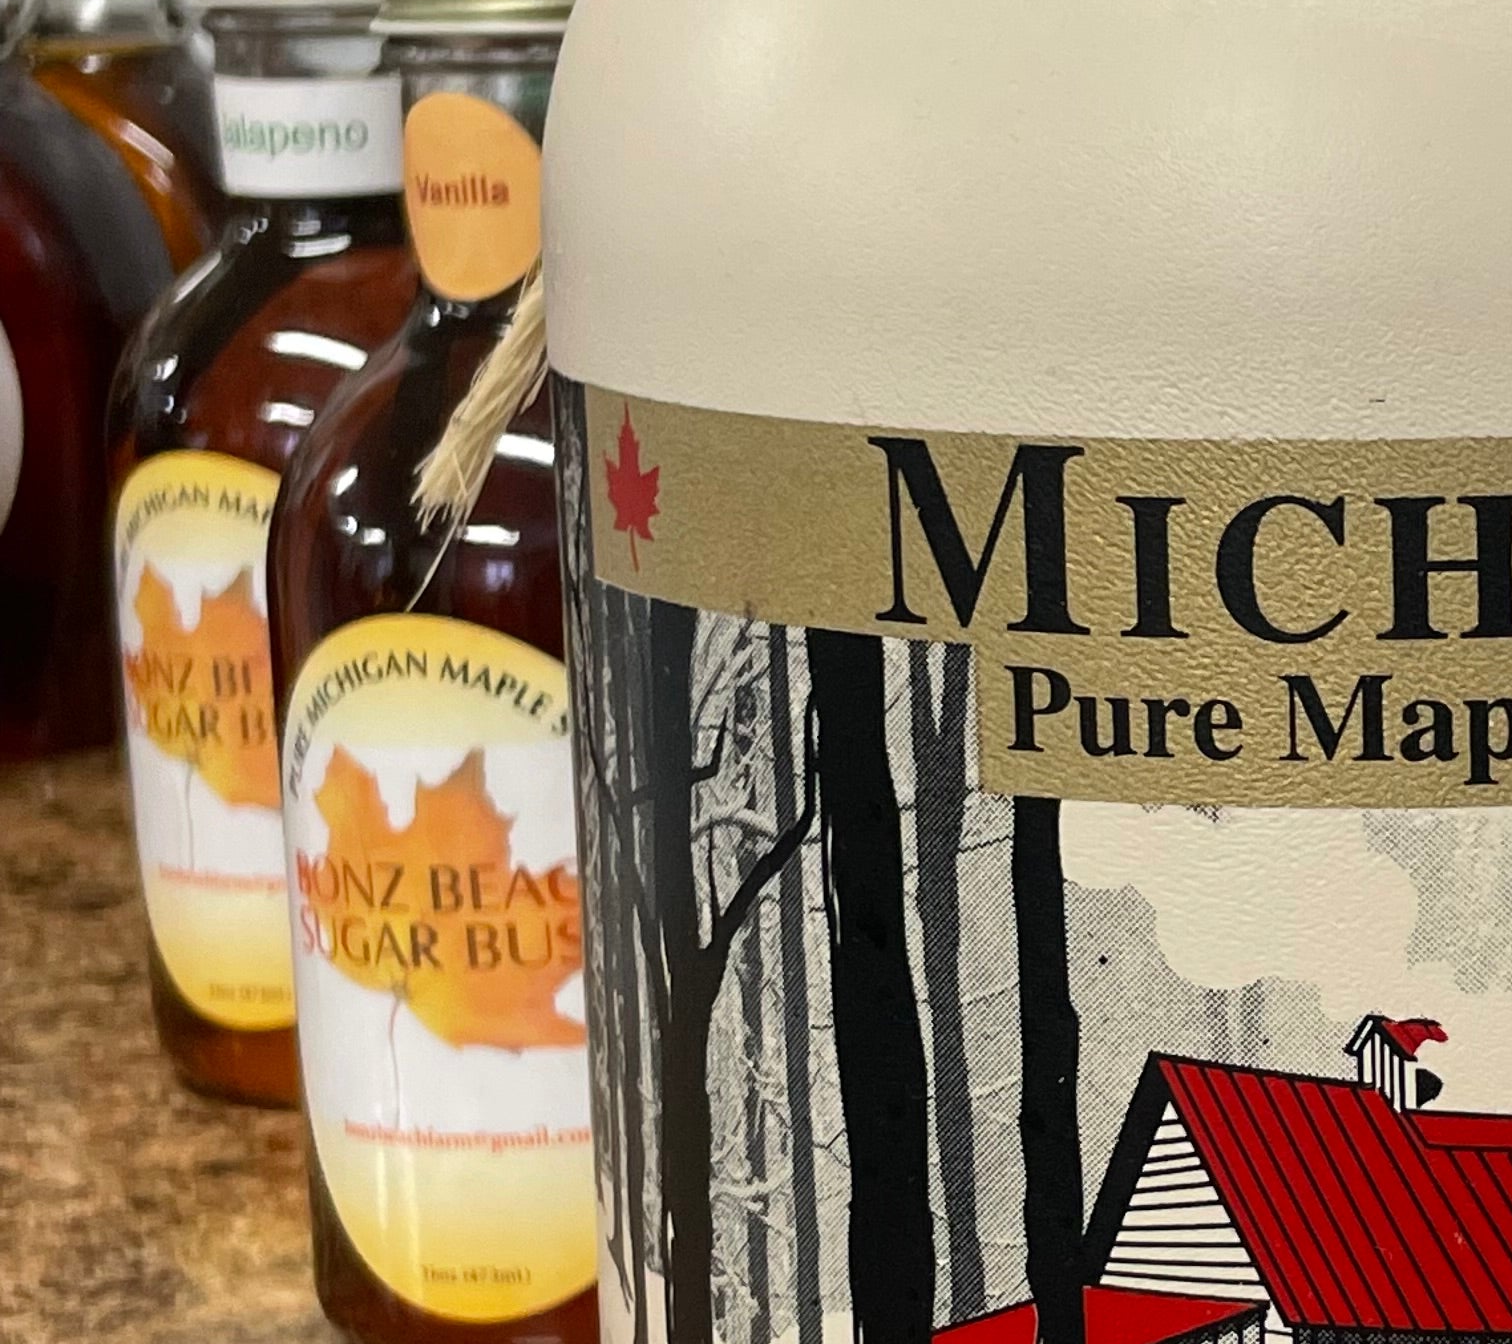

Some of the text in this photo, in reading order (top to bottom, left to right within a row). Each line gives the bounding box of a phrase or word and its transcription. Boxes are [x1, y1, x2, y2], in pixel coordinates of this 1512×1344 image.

[414, 173, 511, 206] Vanilla
[306, 648, 429, 729] MICHIGAN
[439, 652, 554, 721] MAPLE
[1005, 663, 1244, 761] Pure
[296, 848, 410, 913] BONZ
[301, 906, 442, 971] SUGAR
